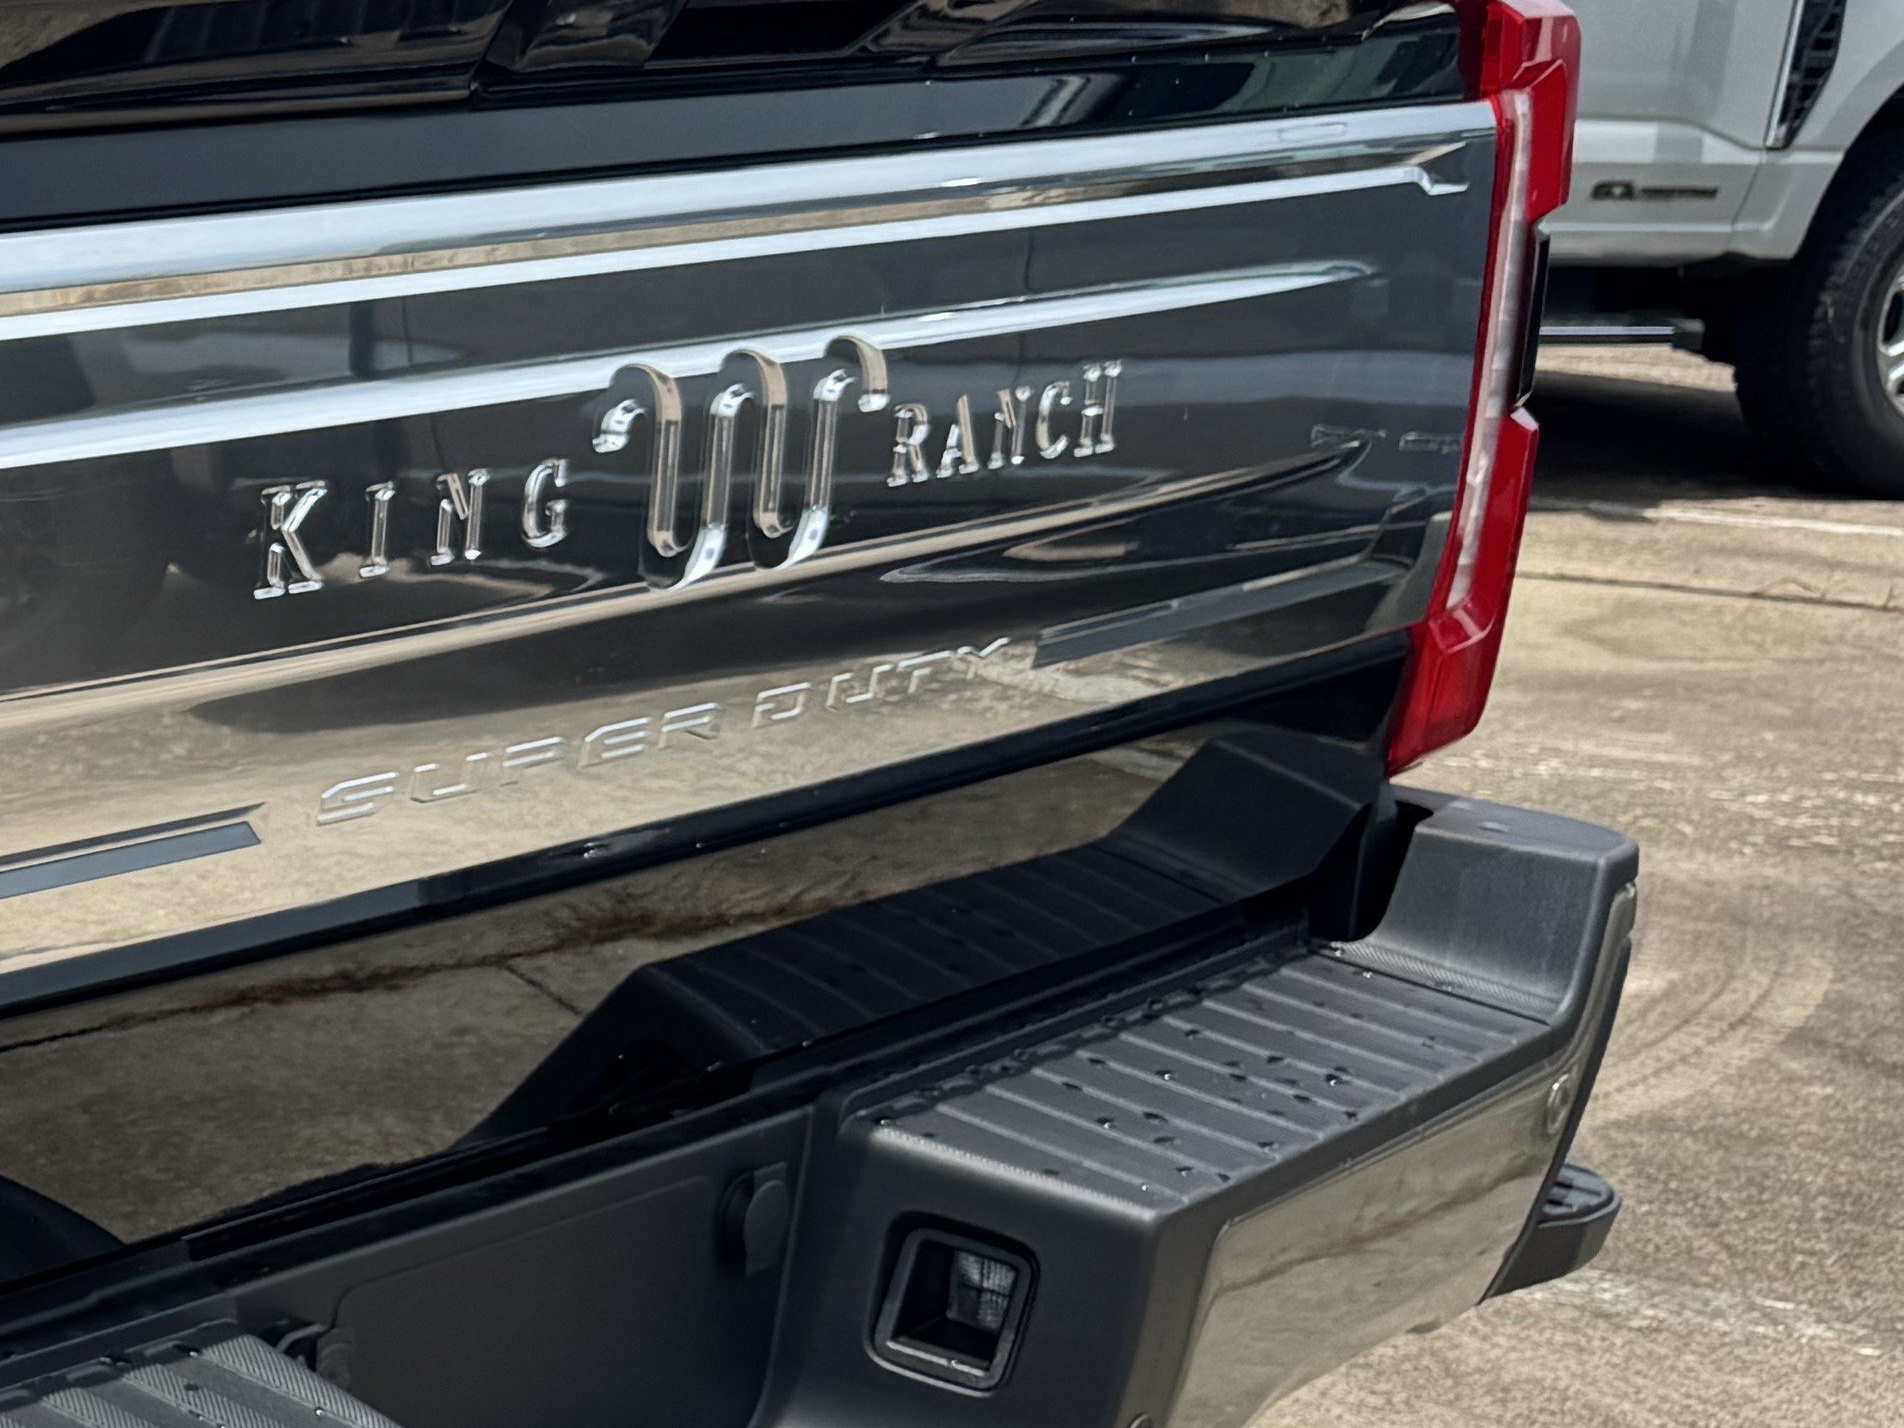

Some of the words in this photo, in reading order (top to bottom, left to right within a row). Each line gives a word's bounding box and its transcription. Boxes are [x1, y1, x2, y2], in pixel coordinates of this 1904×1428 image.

[252, 458, 570, 601] KING
[886, 358, 1124, 487] RANCH
[315, 702, 722, 827] SUPER
[751, 636, 1011, 729] DUTY
